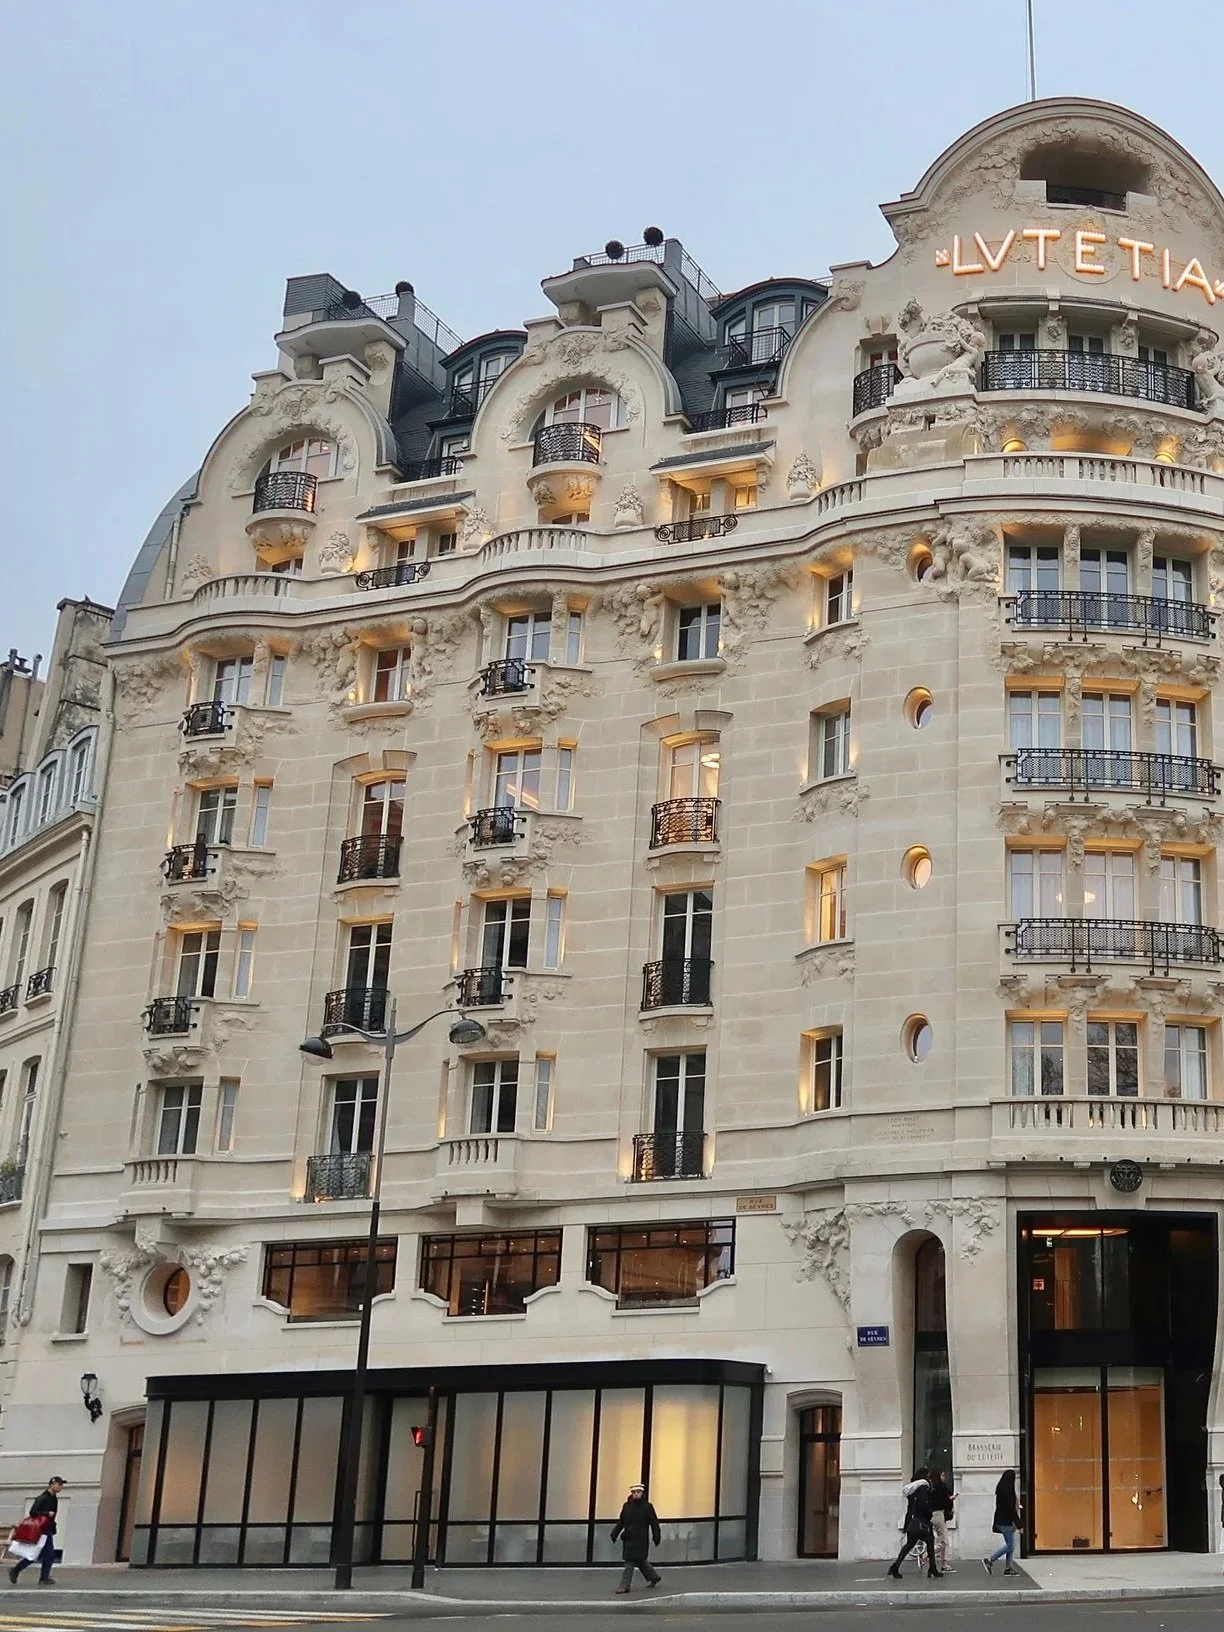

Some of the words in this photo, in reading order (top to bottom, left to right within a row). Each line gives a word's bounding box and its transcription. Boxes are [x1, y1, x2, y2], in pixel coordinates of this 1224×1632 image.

[951, 228, 1217, 305] LVTETIA
[968, 1444, 1002, 1452] BRASSERIE
[978, 1453, 1003, 1461] LUTETIA
